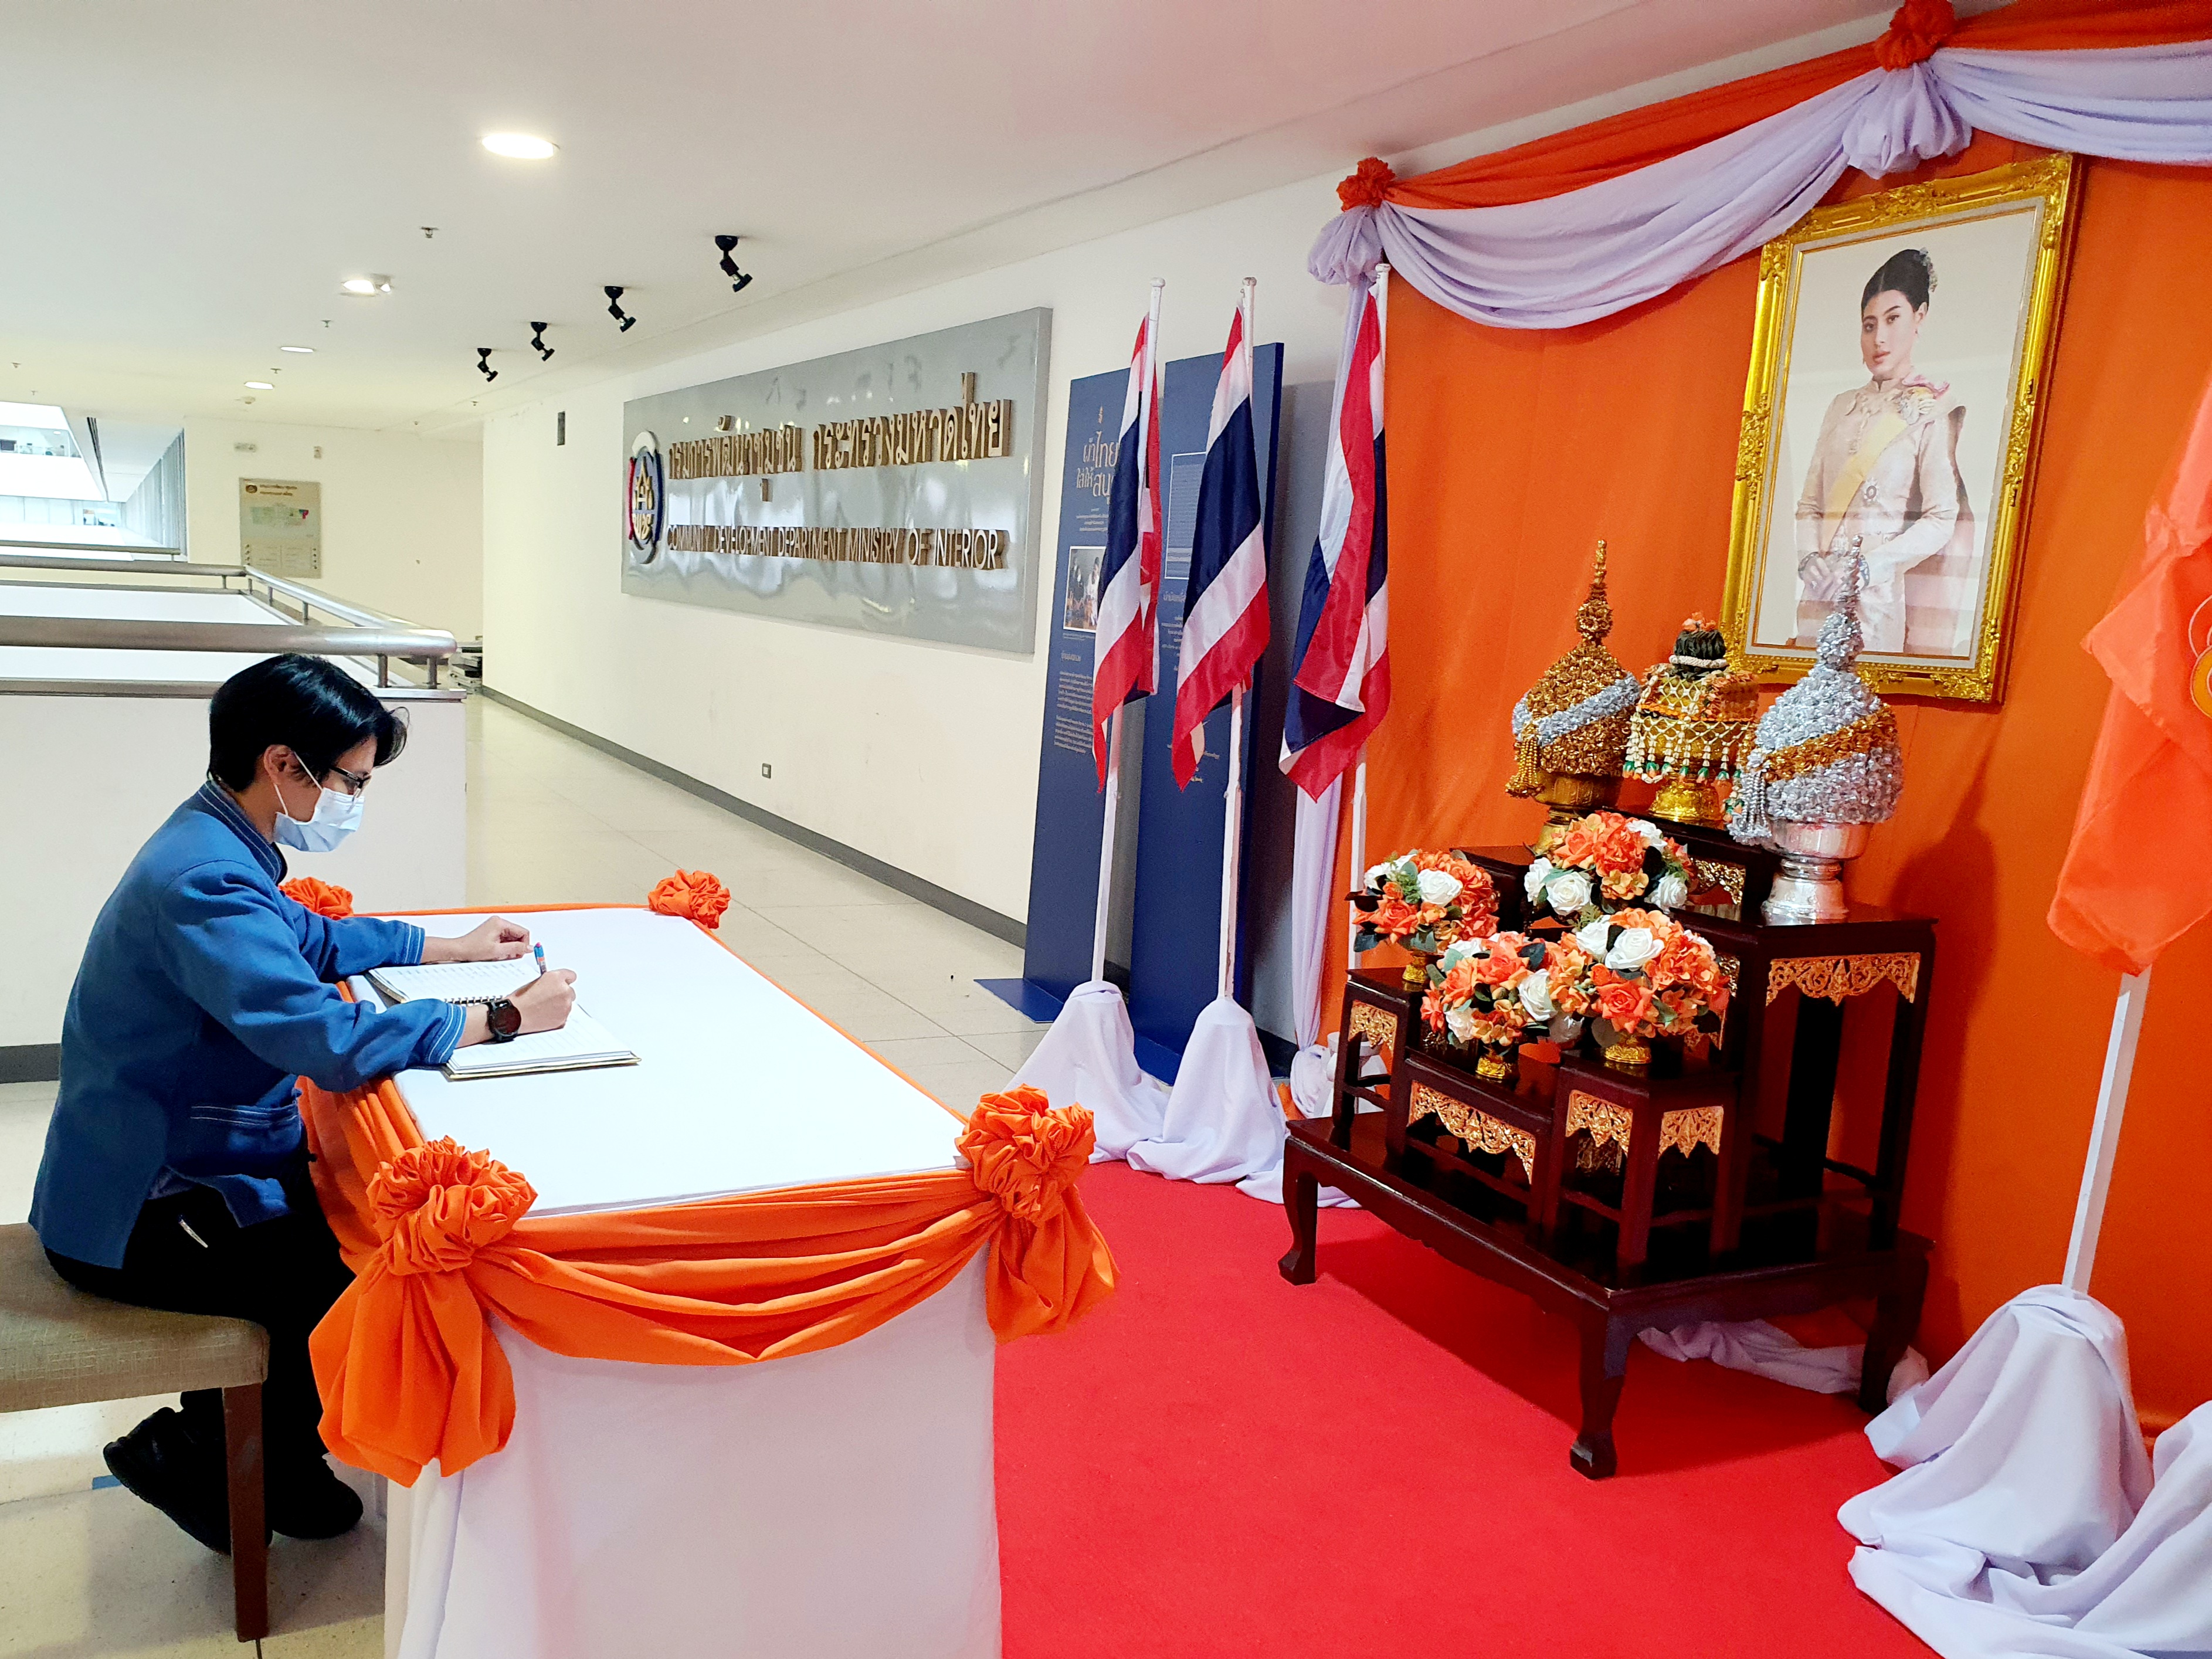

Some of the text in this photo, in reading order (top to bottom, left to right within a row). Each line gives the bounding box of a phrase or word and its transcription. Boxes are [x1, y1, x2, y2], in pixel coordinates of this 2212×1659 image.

[669, 372, 1011, 503] กรมการพัฒนาชุมชน กระทรวงมหาดไทย
[666, 524, 1006, 571] COMMUNITY DEVELOPMENT DEPARTMENT MINISTRY OF INTERIOR
